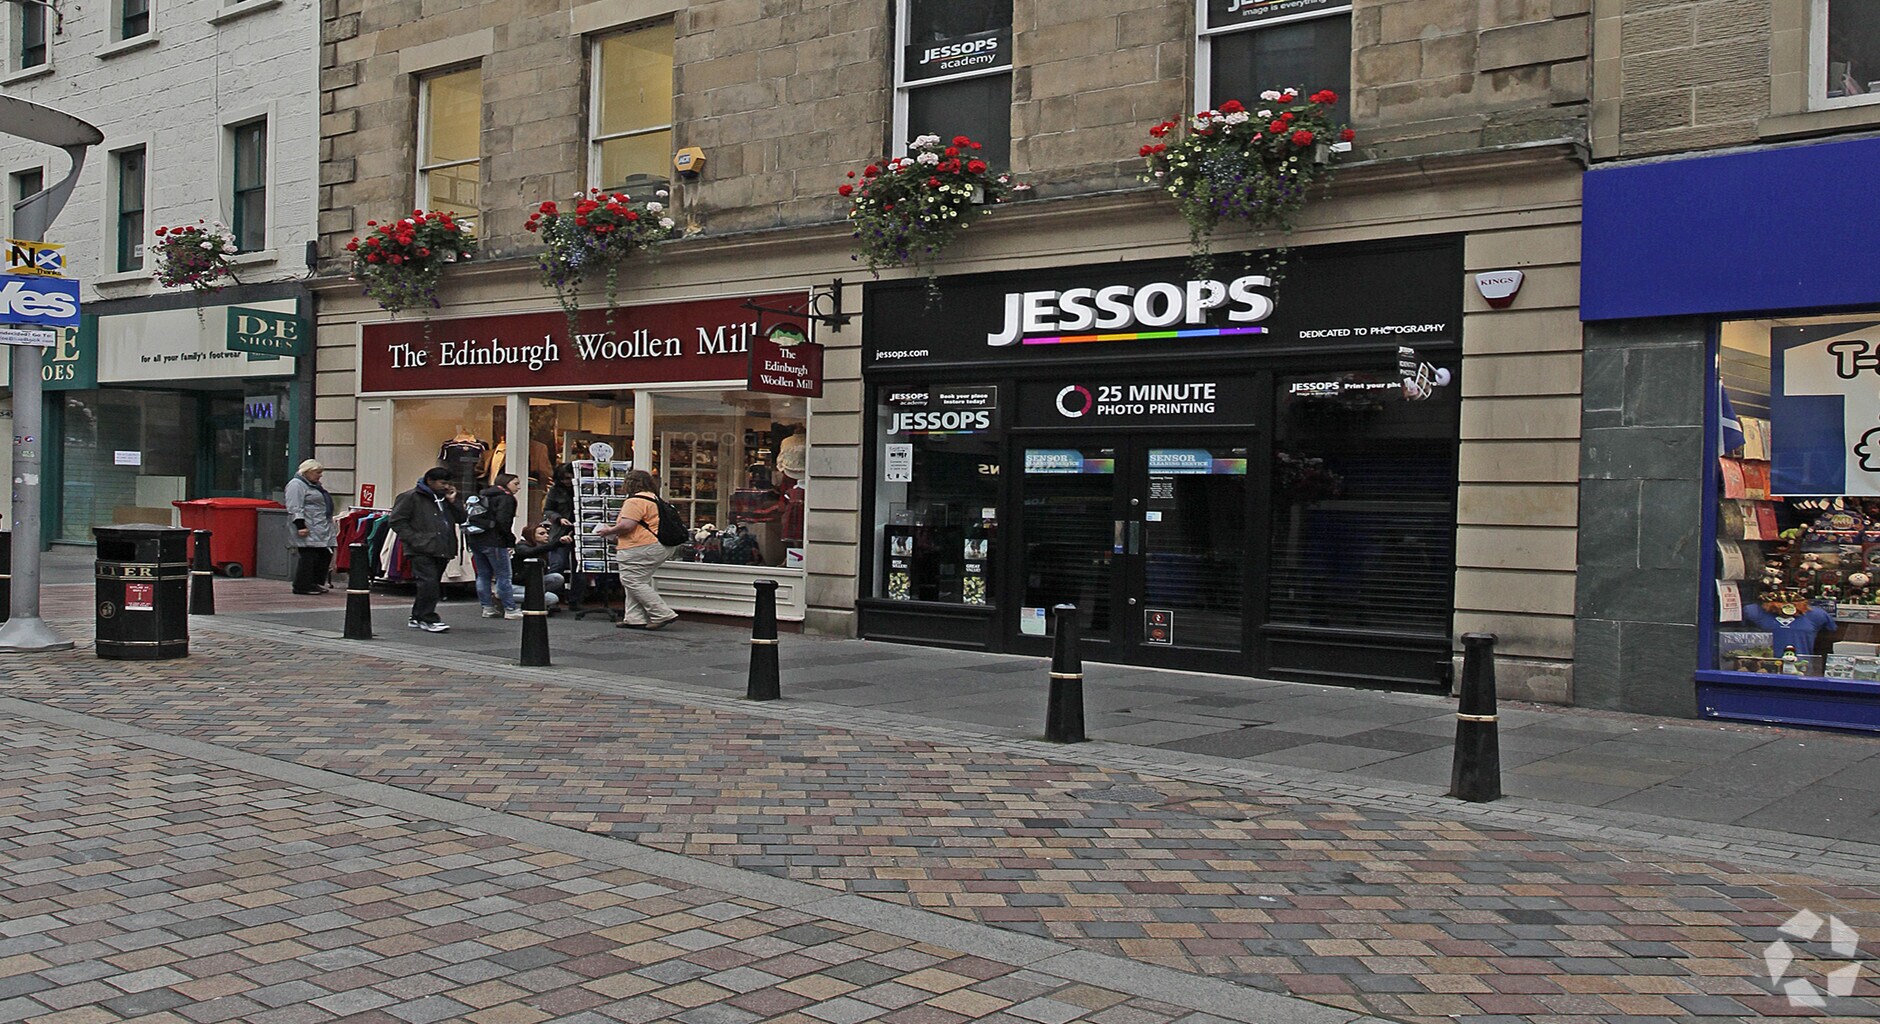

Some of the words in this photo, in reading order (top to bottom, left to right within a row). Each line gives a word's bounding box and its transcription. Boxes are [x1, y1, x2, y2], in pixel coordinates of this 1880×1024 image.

[1242, 6, 1268, 16] image
[1270, 3, 1278, 11] is
[920, 37, 998, 64] JESSOPS
[940, 54, 995, 69] academy
[1480, 277, 1514, 286] KINGS
[987, 275, 1274, 347] JESSOPS
[1299, 329, 1351, 339] DEDICATED
[1353, 327, 1367, 336] TO
[239, 336, 293, 348] SHOES
[388, 343, 428, 369] The
[438, 335, 560, 371] Edinburgh
[575, 328, 682, 361] Woollen
[780, 348, 796, 359] The
[875, 349, 929, 360] jessops.com
[141, 354, 151, 363] for
[153, 353, 161, 362] all
[163, 354, 178, 364] your
[180, 351, 206, 363] family's
[209, 350, 242, 360] footwear
[42, 363, 75, 381] OES
[764, 360, 808, 376] Edinburgh
[760, 374, 794, 388] Woollen
[796, 378, 813, 389] Mill
[1289, 381, 1340, 393] JESSOPS
[889, 392, 929, 402] JESSOPS
[1097, 385, 1123, 402] 25
[1129, 383, 1216, 401] MINUTE
[1097, 404, 1144, 415] PHOTO
[1149, 402, 1215, 414] PRINTING
[887, 410, 990, 435] JESSOPS
[1025, 454, 1068, 462] SENSOR
[1149, 454, 1196, 462] SENSOR
